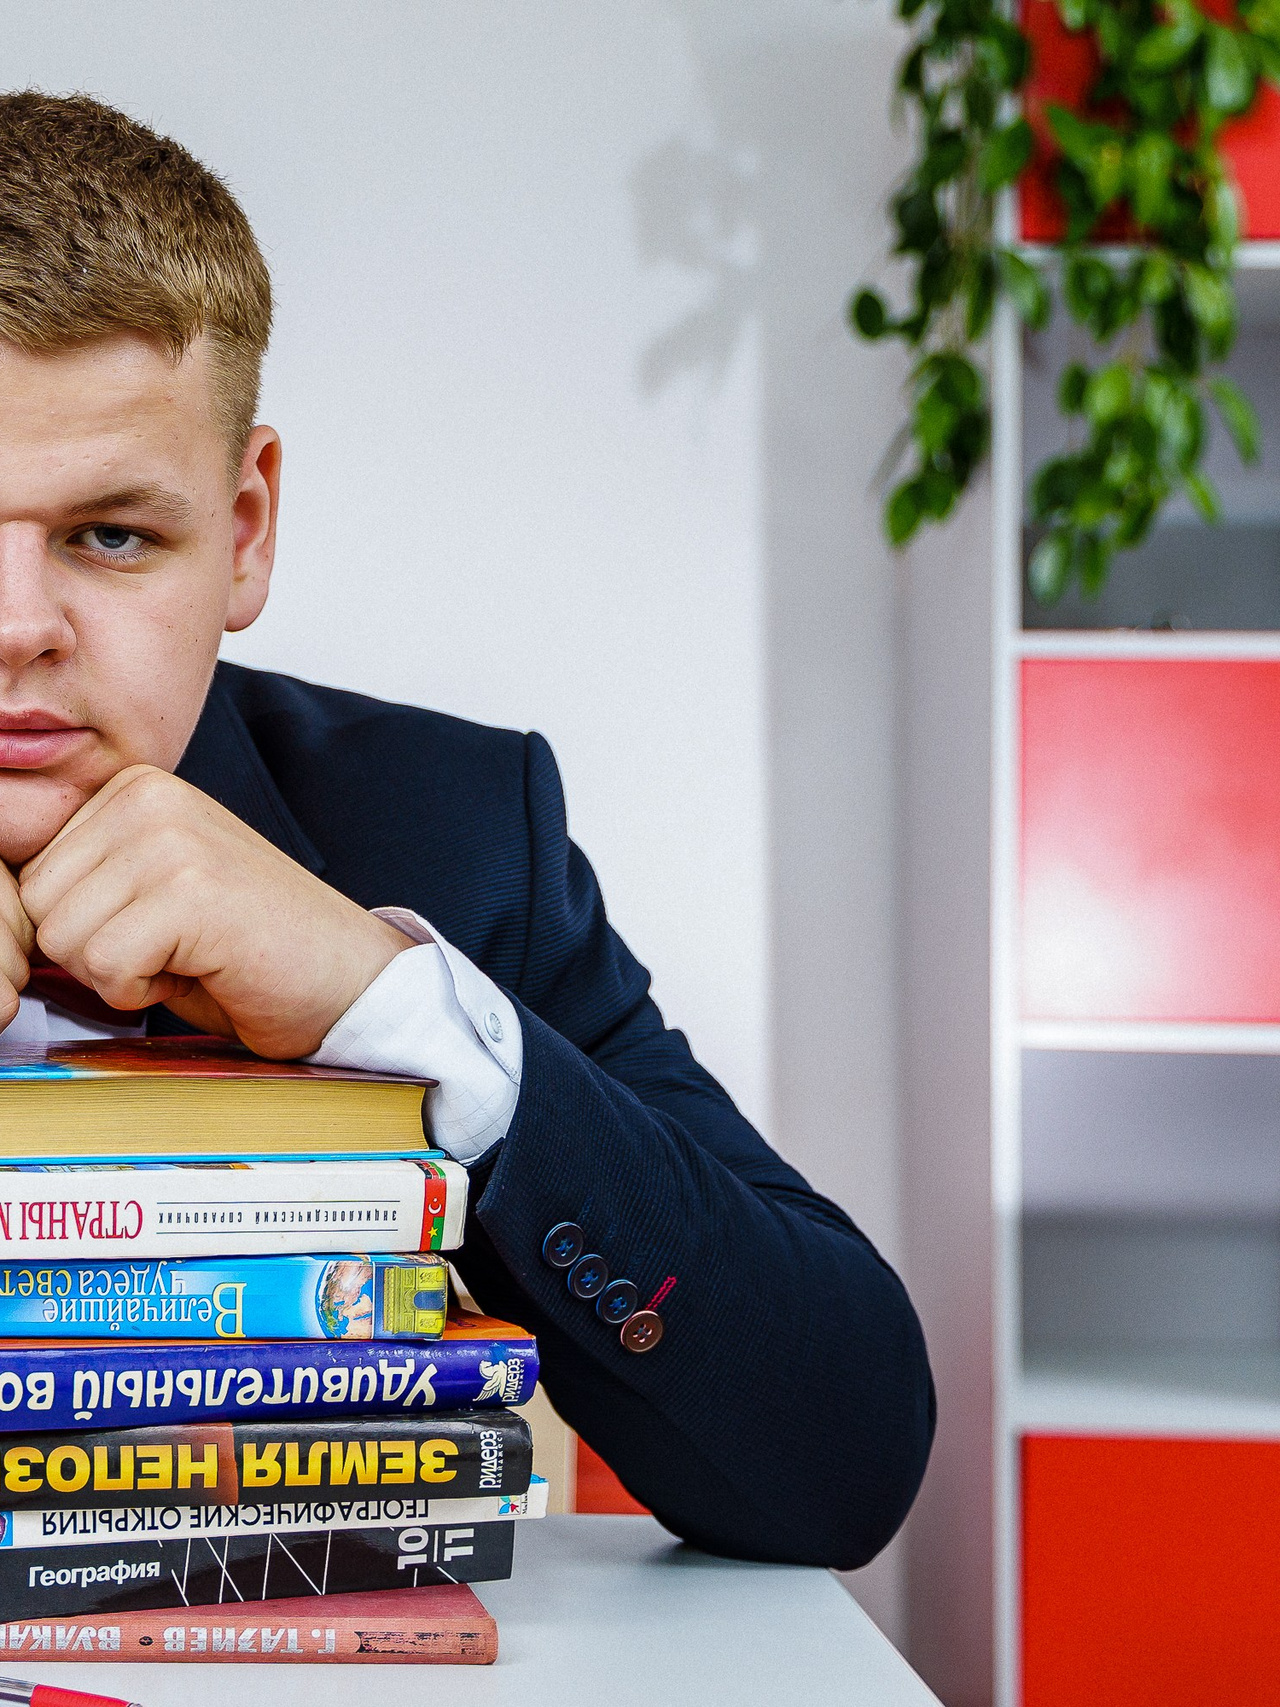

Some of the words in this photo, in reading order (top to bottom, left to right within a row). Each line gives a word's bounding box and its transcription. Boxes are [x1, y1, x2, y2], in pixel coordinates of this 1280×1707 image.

[19, 1200, 143, 1240] СТРАНЫ
[159, 1210, 242, 1224] СПРАВОЧНИК
[255, 1209, 397, 1225] ЭНЦИКЛОПЕДИЧЕСКИЙ
[43, 1282, 247, 1338] Величайшие
[242, 1439, 459, 1488] ЗЕМЛЯ
[42, 1506, 181, 1536] ОТКРЫТИЯ
[190, 1499, 429, 1528] ГЕОГРАФИЧЕСКИЕ
[397, 1526, 429, 1570] 10
[443, 1528, 474, 1562] 11
[29, 1560, 160, 1587] География
[163, 1626, 303, 1653] ТАЗИЕВ
[312, 1628, 335, 1653] Г.
